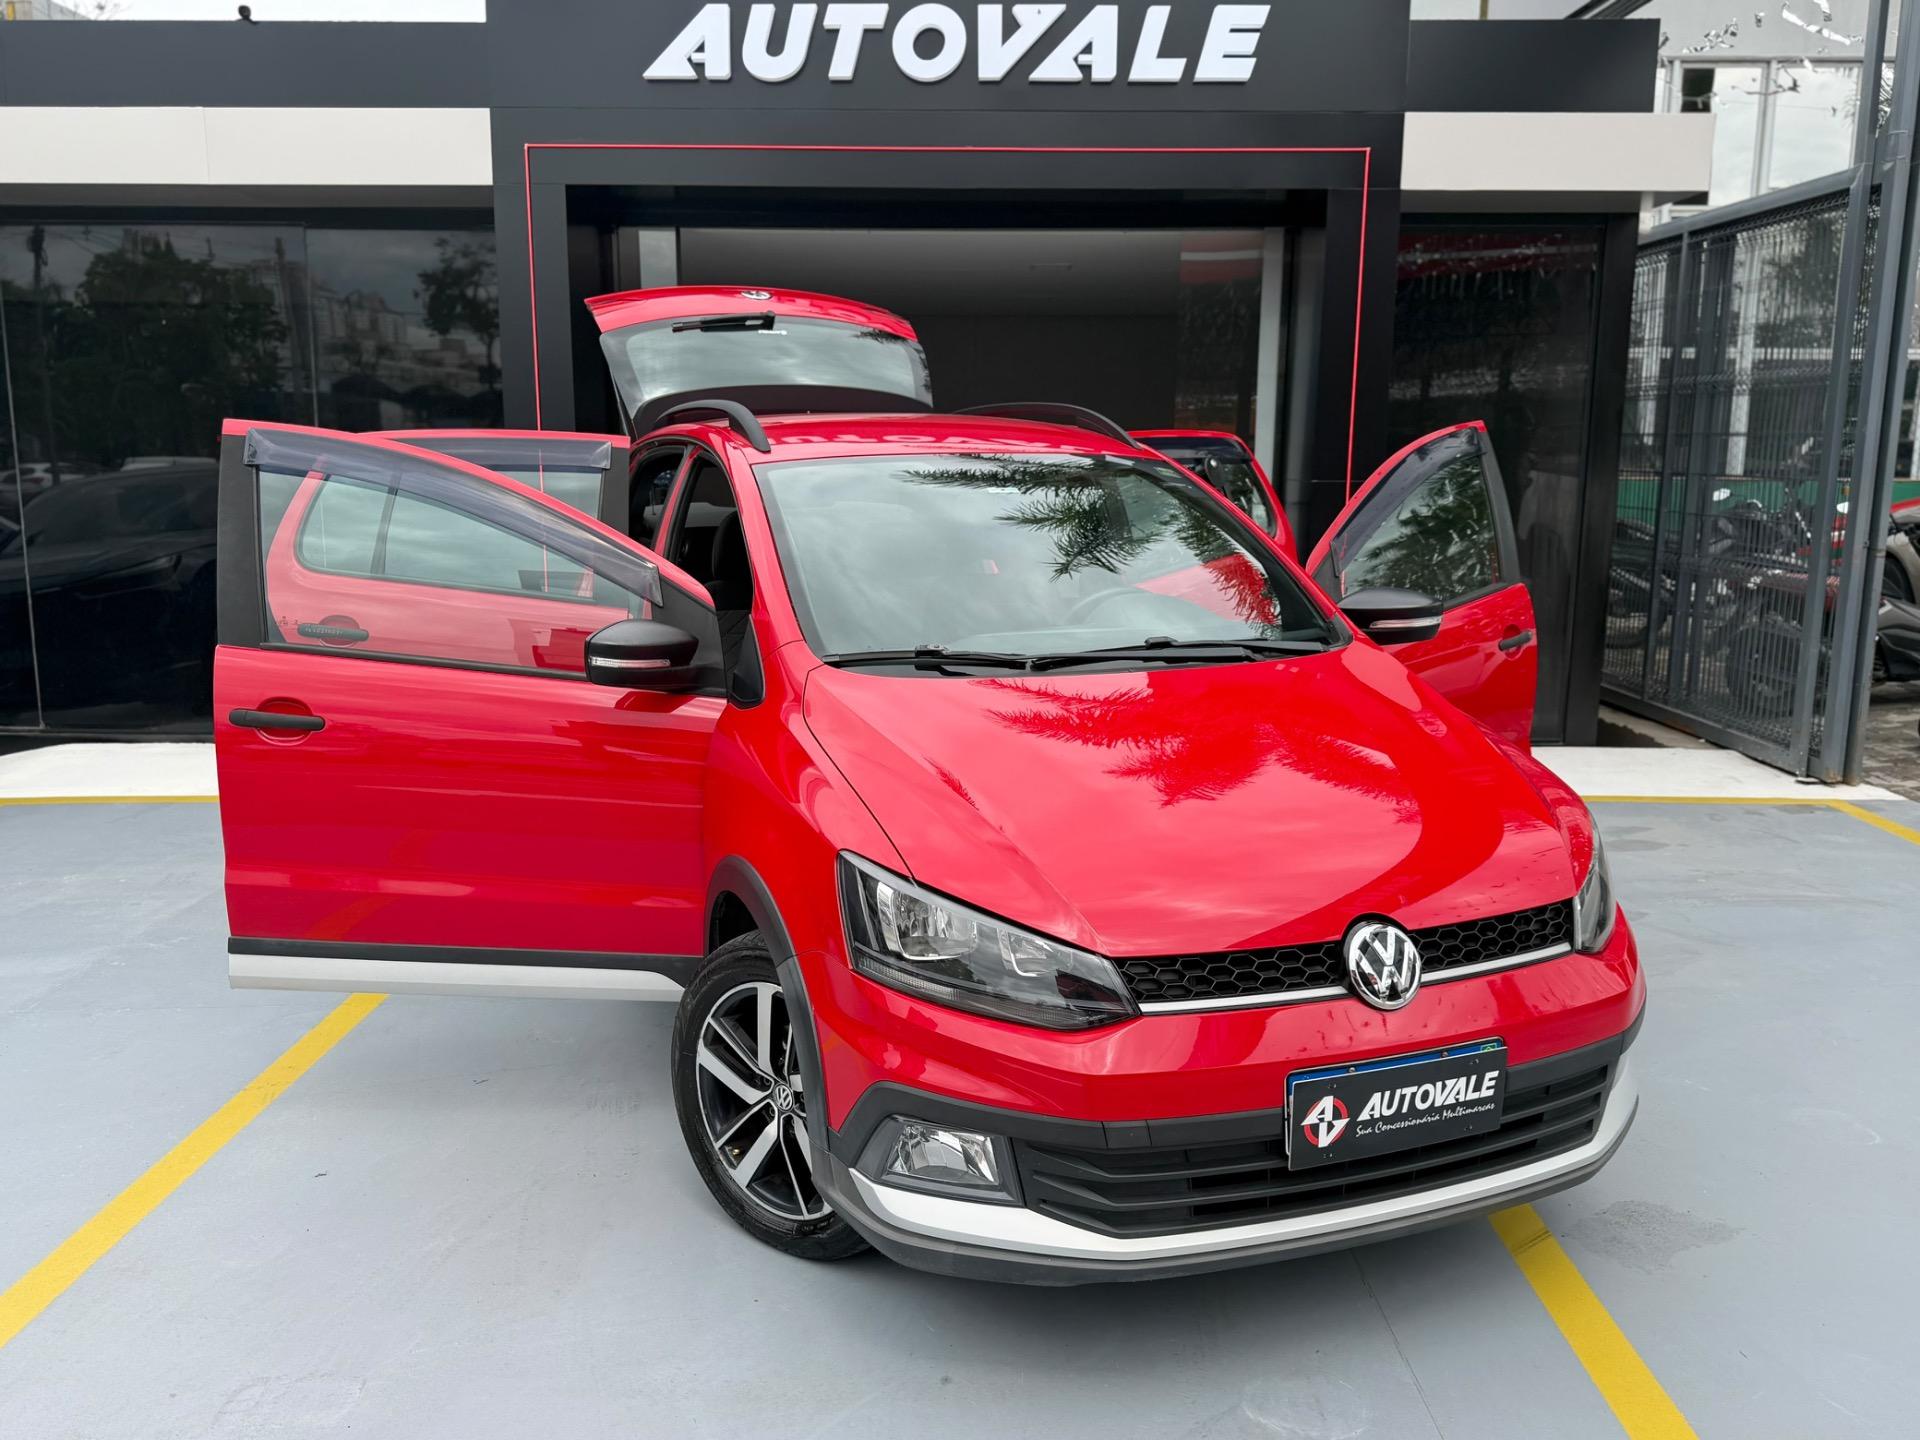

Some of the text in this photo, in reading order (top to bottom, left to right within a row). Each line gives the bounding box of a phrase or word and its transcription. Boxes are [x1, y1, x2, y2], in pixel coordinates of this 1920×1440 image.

[642, 3, 1272, 82] AUTOVALE
[1356, 1070, 1500, 1121] AUTOVALE
[1356, 1124, 1373, 1137] Sua
[1442, 1103, 1495, 1120] Multimarcas
